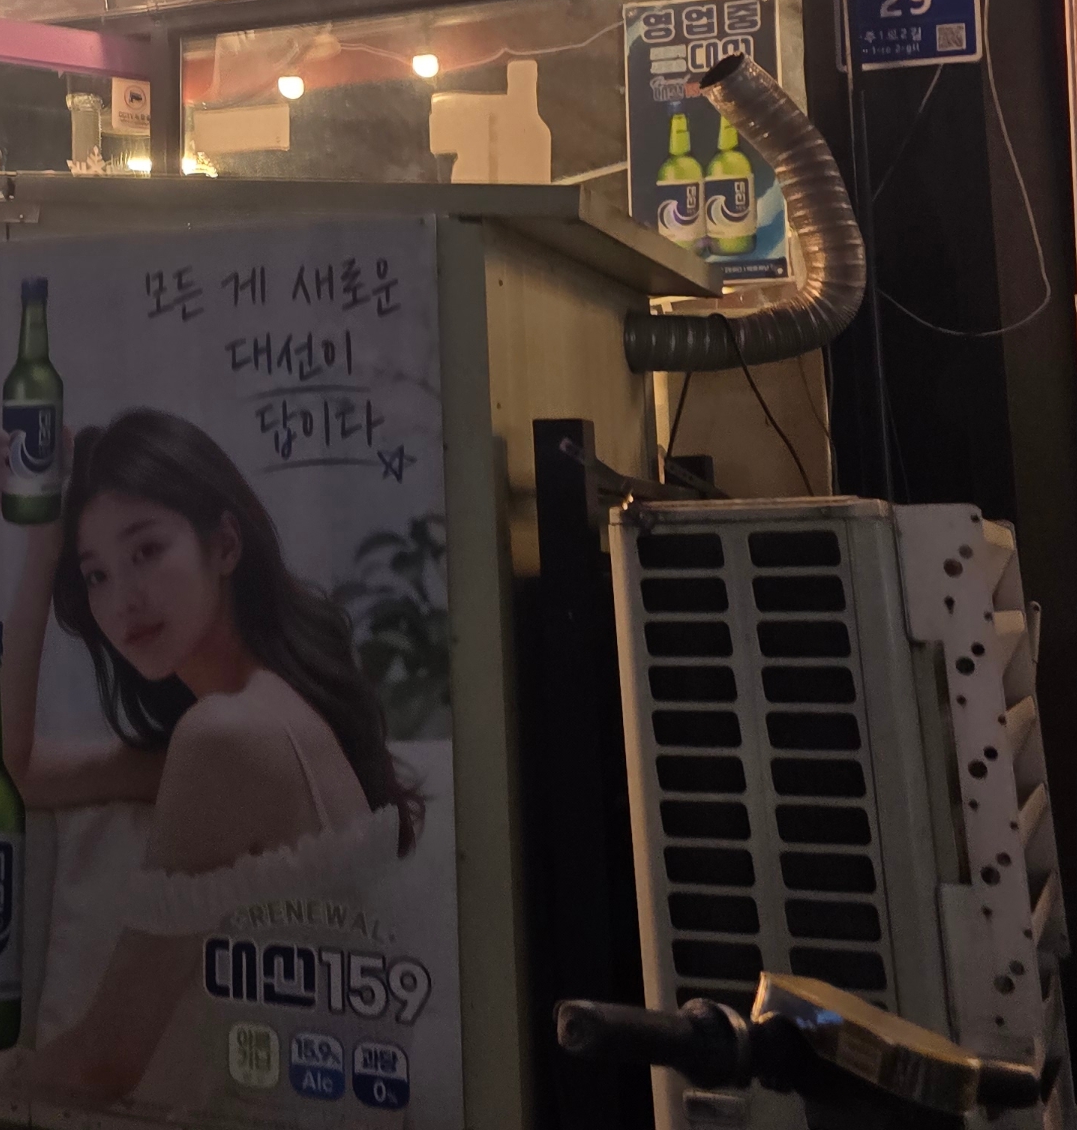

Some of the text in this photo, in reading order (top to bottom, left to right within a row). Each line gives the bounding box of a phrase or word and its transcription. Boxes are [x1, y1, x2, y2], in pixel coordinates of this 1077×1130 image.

[145, 257, 401, 322] 모든 게 새로운
[225, 329, 353, 381] 대선이
[248, 899, 384, 943] RENEWAL
